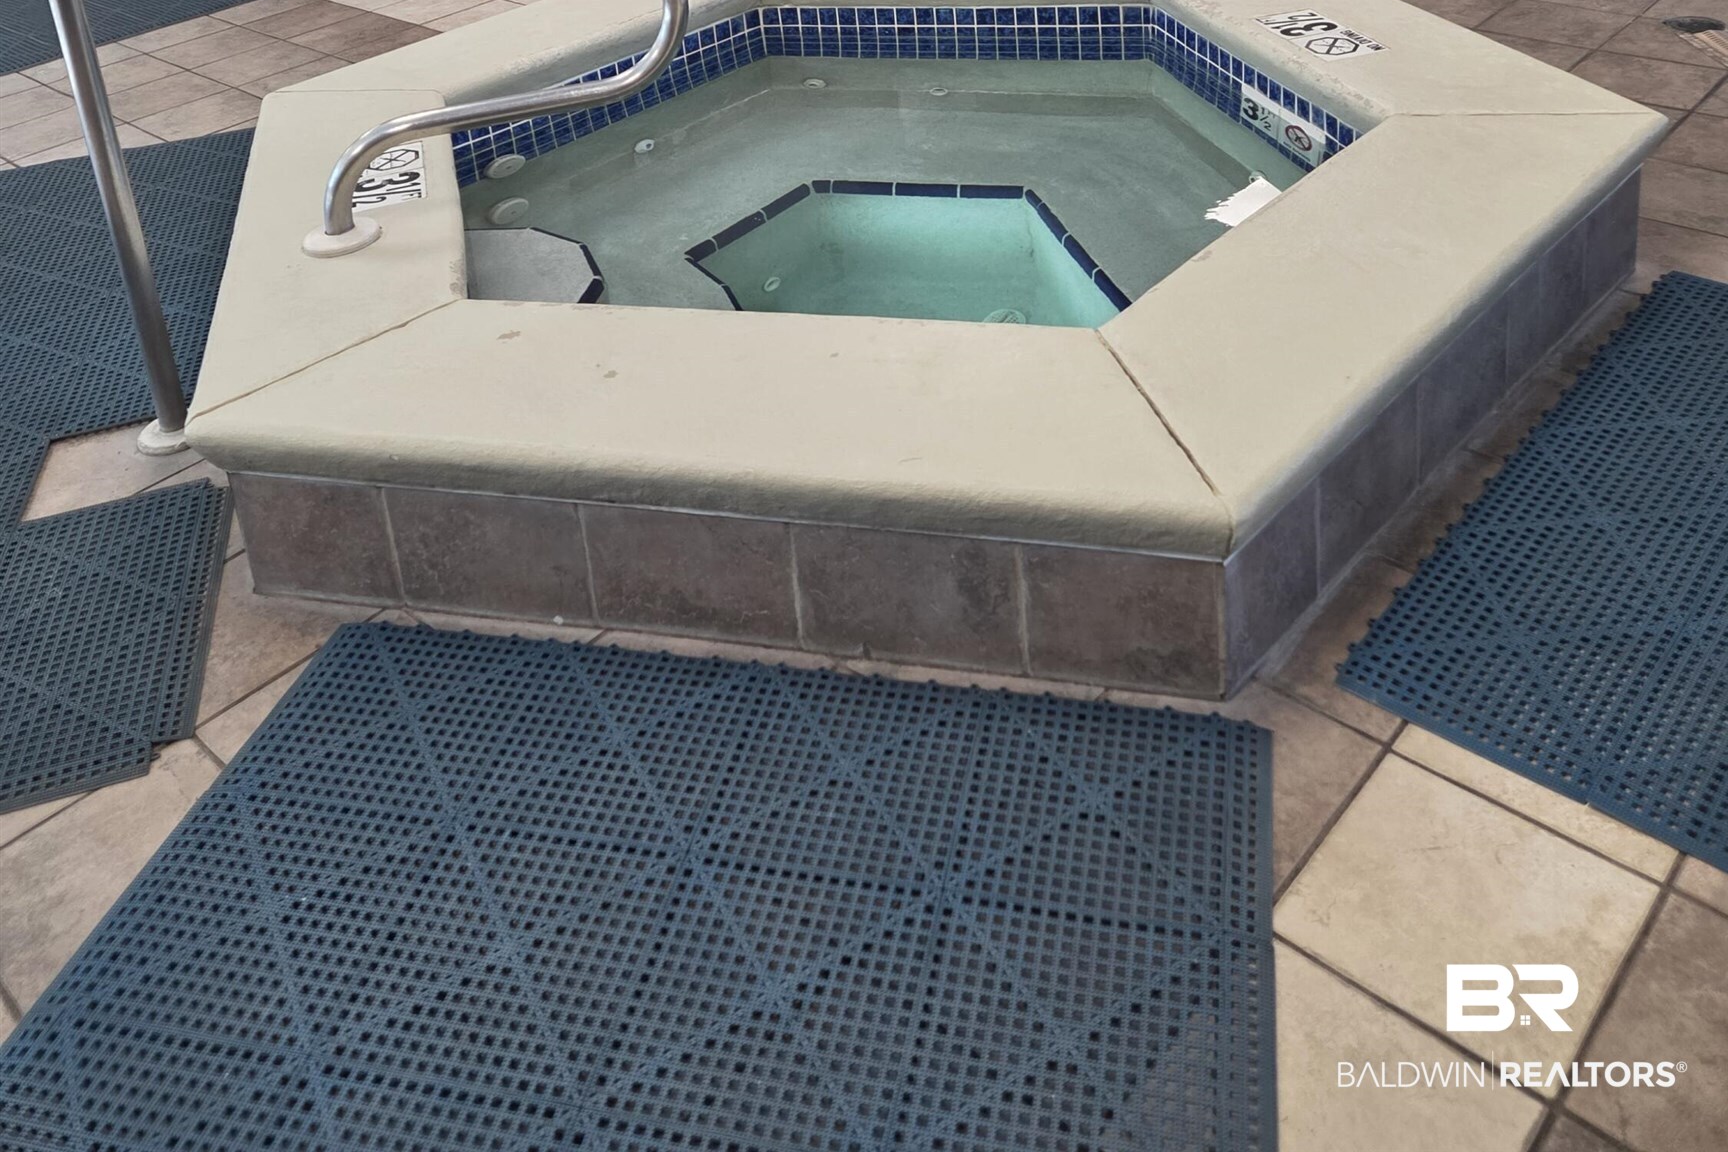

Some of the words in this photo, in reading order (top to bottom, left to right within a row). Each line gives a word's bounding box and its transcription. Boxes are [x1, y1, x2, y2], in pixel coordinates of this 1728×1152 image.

[1339, 29, 1373, 45] DIVING
[1366, 43, 1385, 51] NO
[1242, 97, 1259, 121] 3
